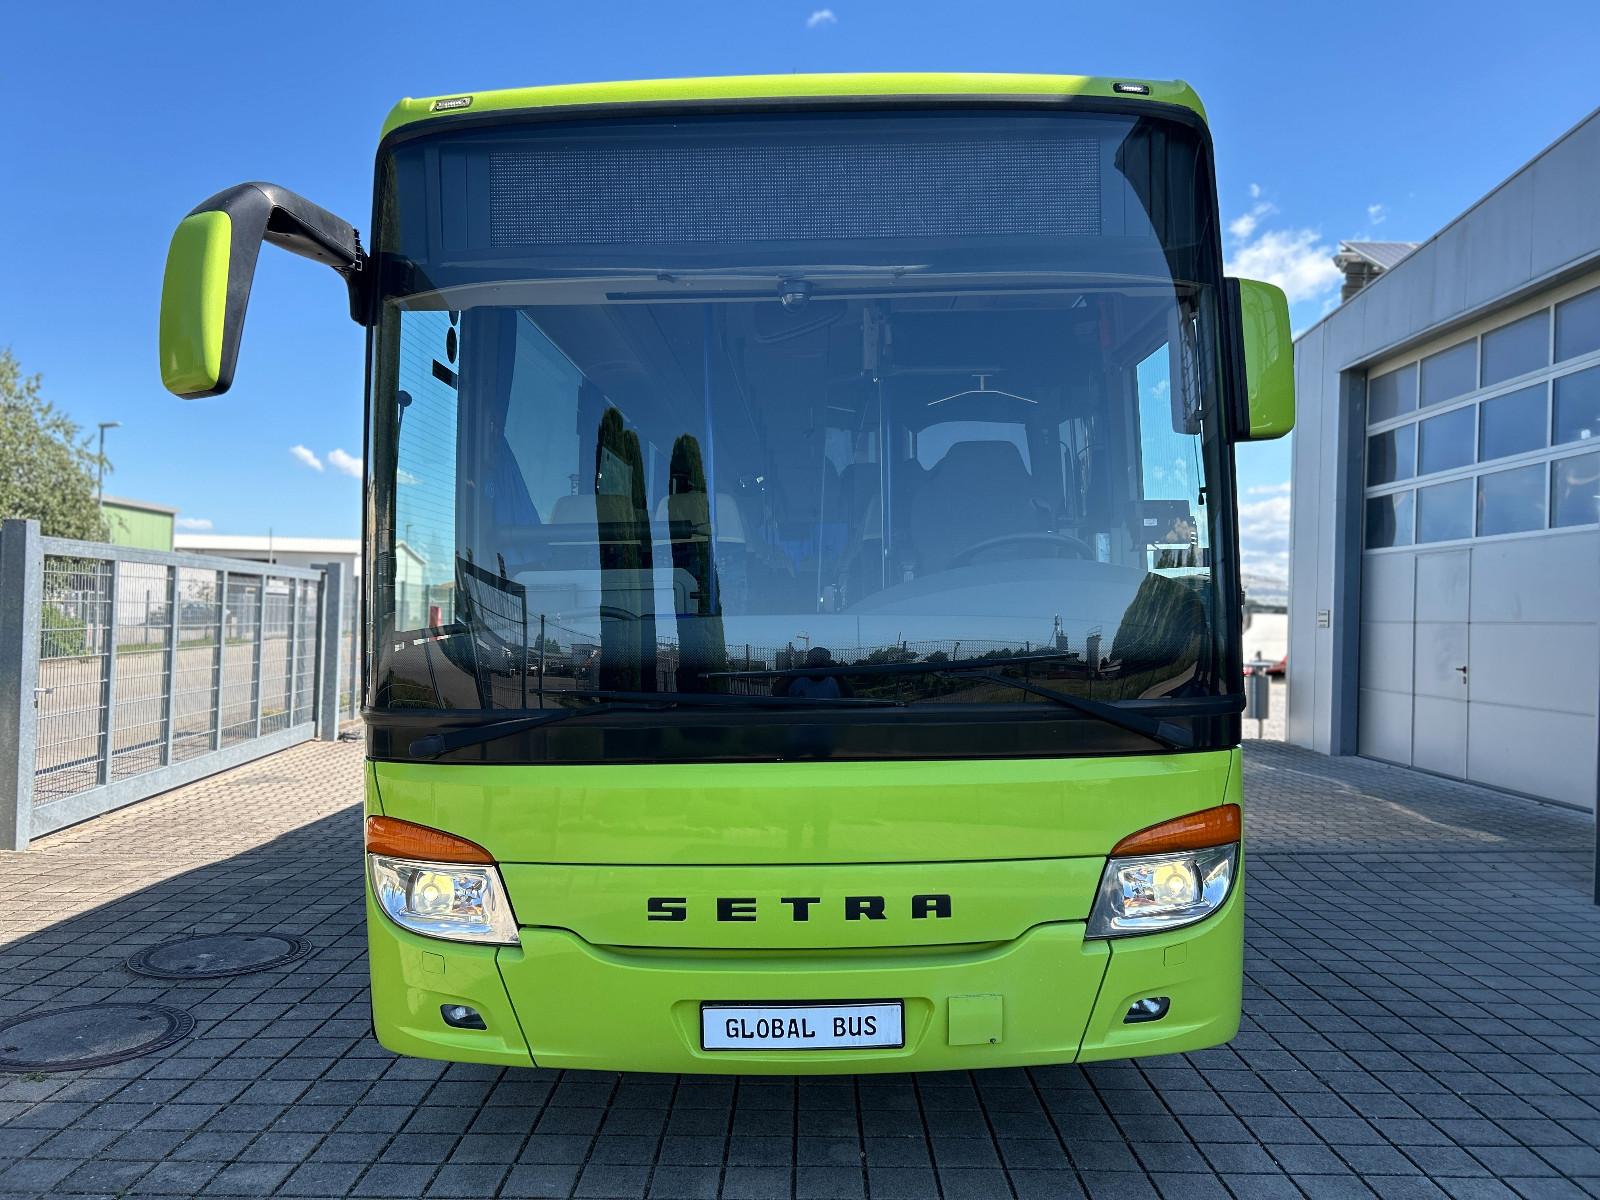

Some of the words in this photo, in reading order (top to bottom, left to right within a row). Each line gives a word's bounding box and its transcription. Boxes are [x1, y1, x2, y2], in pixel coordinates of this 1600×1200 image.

[647, 894, 952, 922] SETRA
[725, 1018, 816, 1039] GLOBAL
[833, 1015, 877, 1037] BUS
